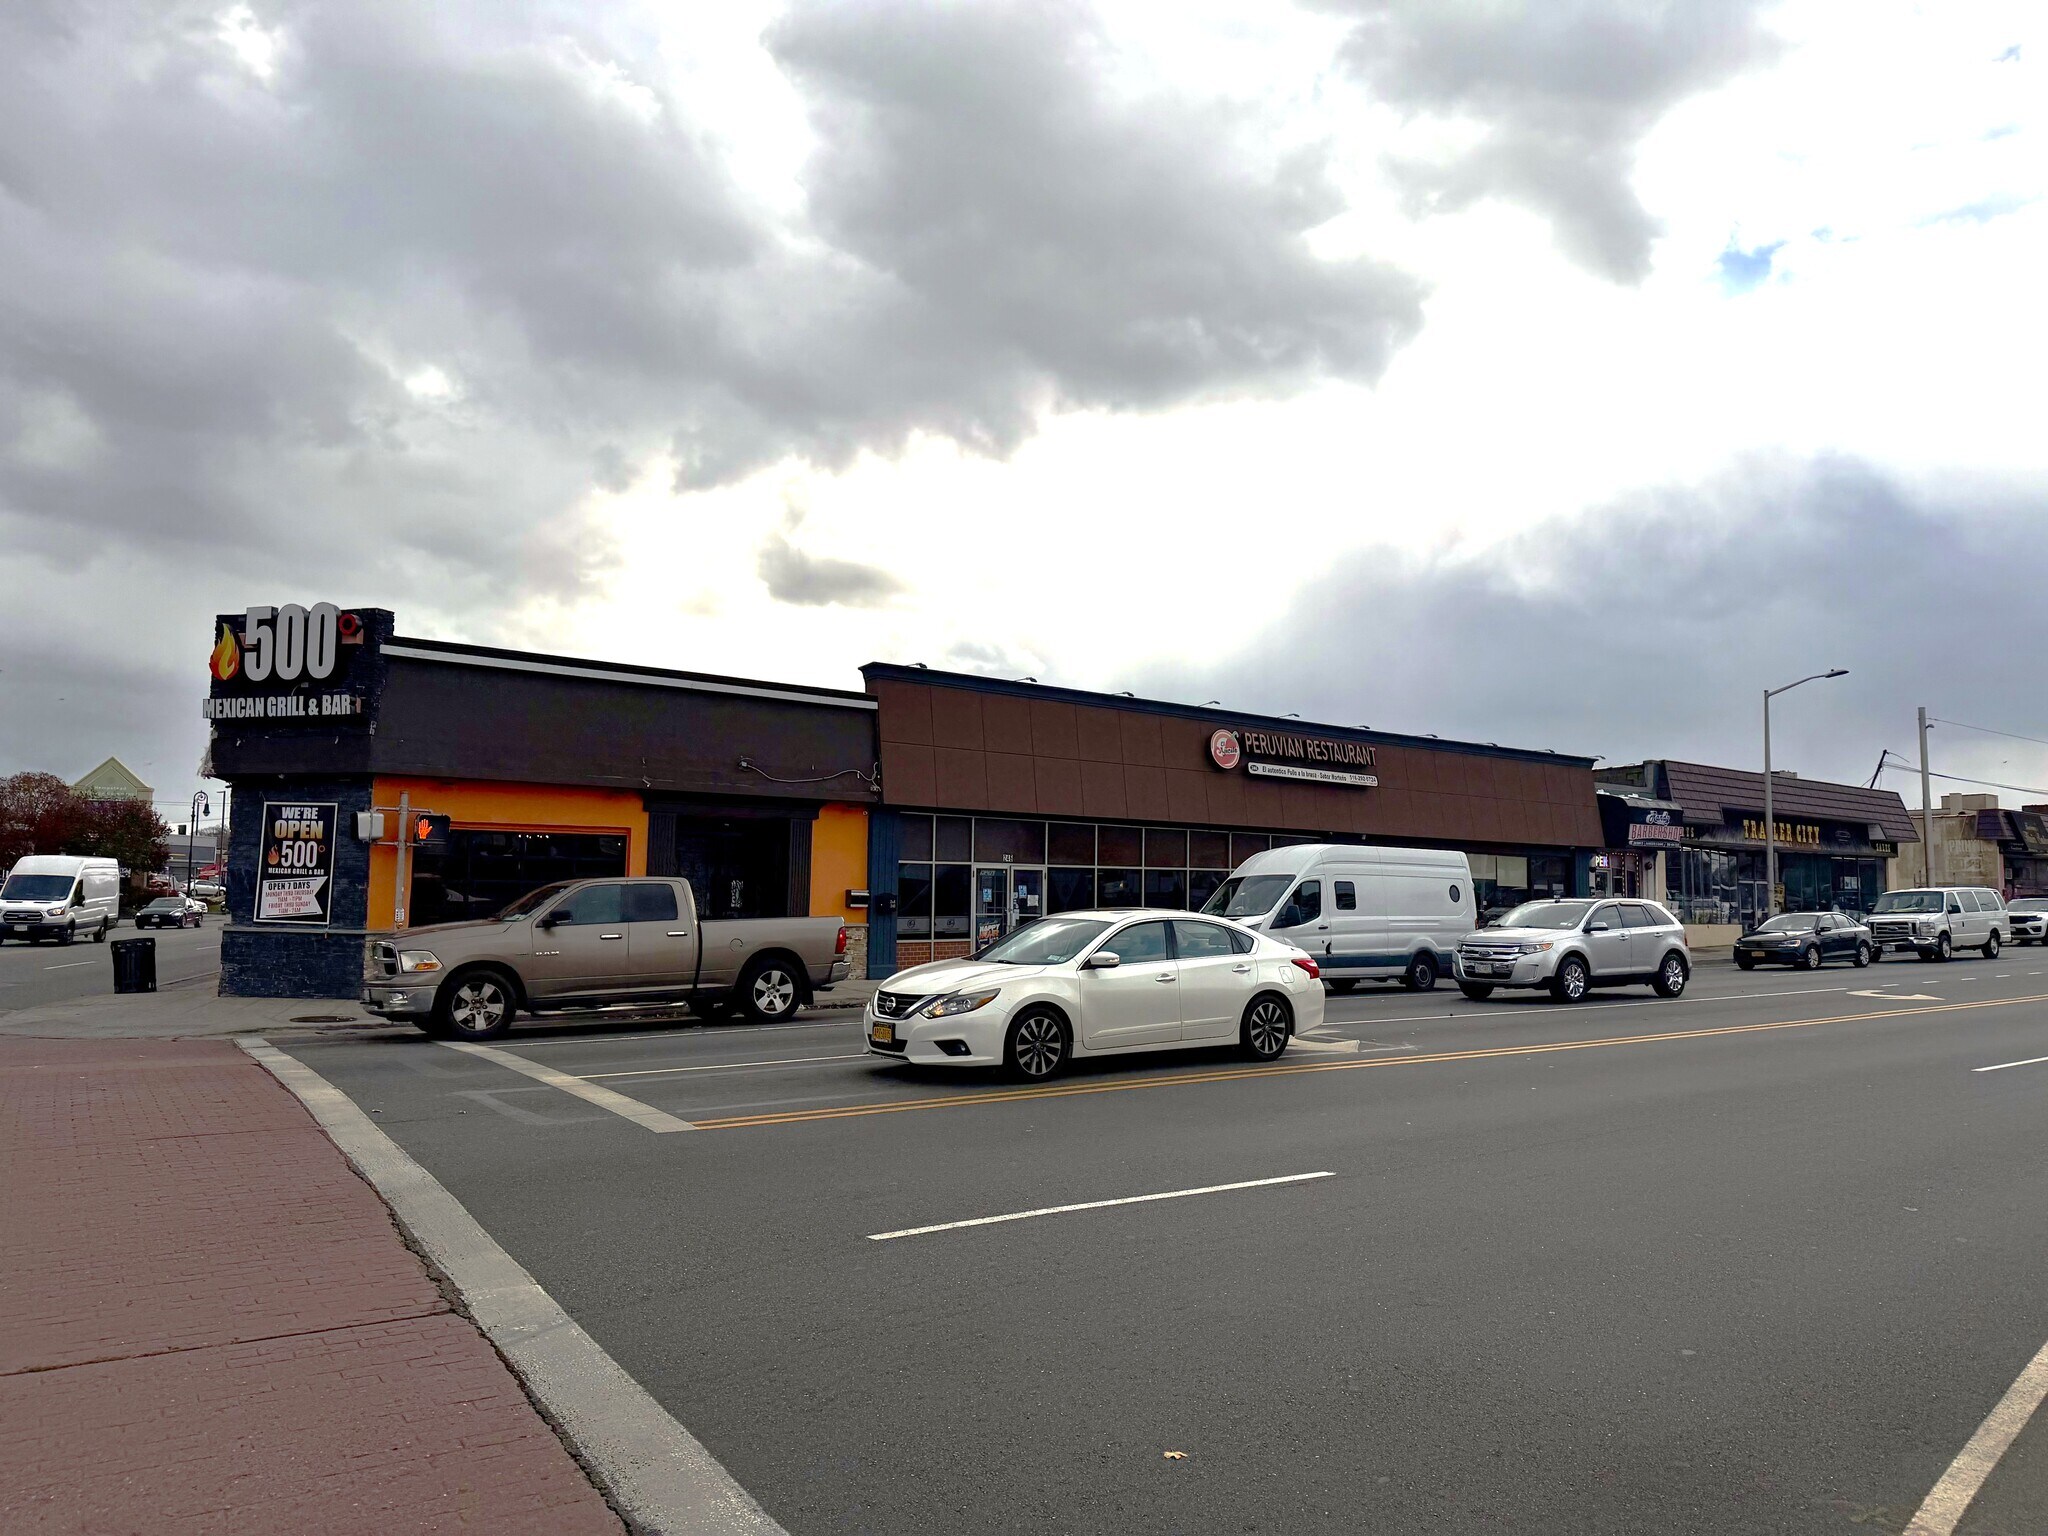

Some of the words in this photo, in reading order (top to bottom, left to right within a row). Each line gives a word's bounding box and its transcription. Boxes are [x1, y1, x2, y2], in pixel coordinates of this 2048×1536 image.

[202, 696, 265, 719] MEXICAN
[266, 695, 306, 718] GRILL
[308, 698, 319, 716] &
[321, 694, 351, 716] BAR
[1244, 732, 1305, 758] PERUVIAN
[1306, 739, 1376, 766] RESTAURANT
[281, 806, 319, 819] WE'RE
[274, 819, 324, 839] OPEN
[1631, 824, 1684, 842] BARBERSHOP
[1742, 819, 1793, 842] TRALER
[1796, 824, 1820, 844] CITY
[265, 890, 283, 898] MONDAY
[268, 883, 286, 891] OPEN
[287, 882, 292, 890] 7
[292, 882, 311, 890] DAYS
